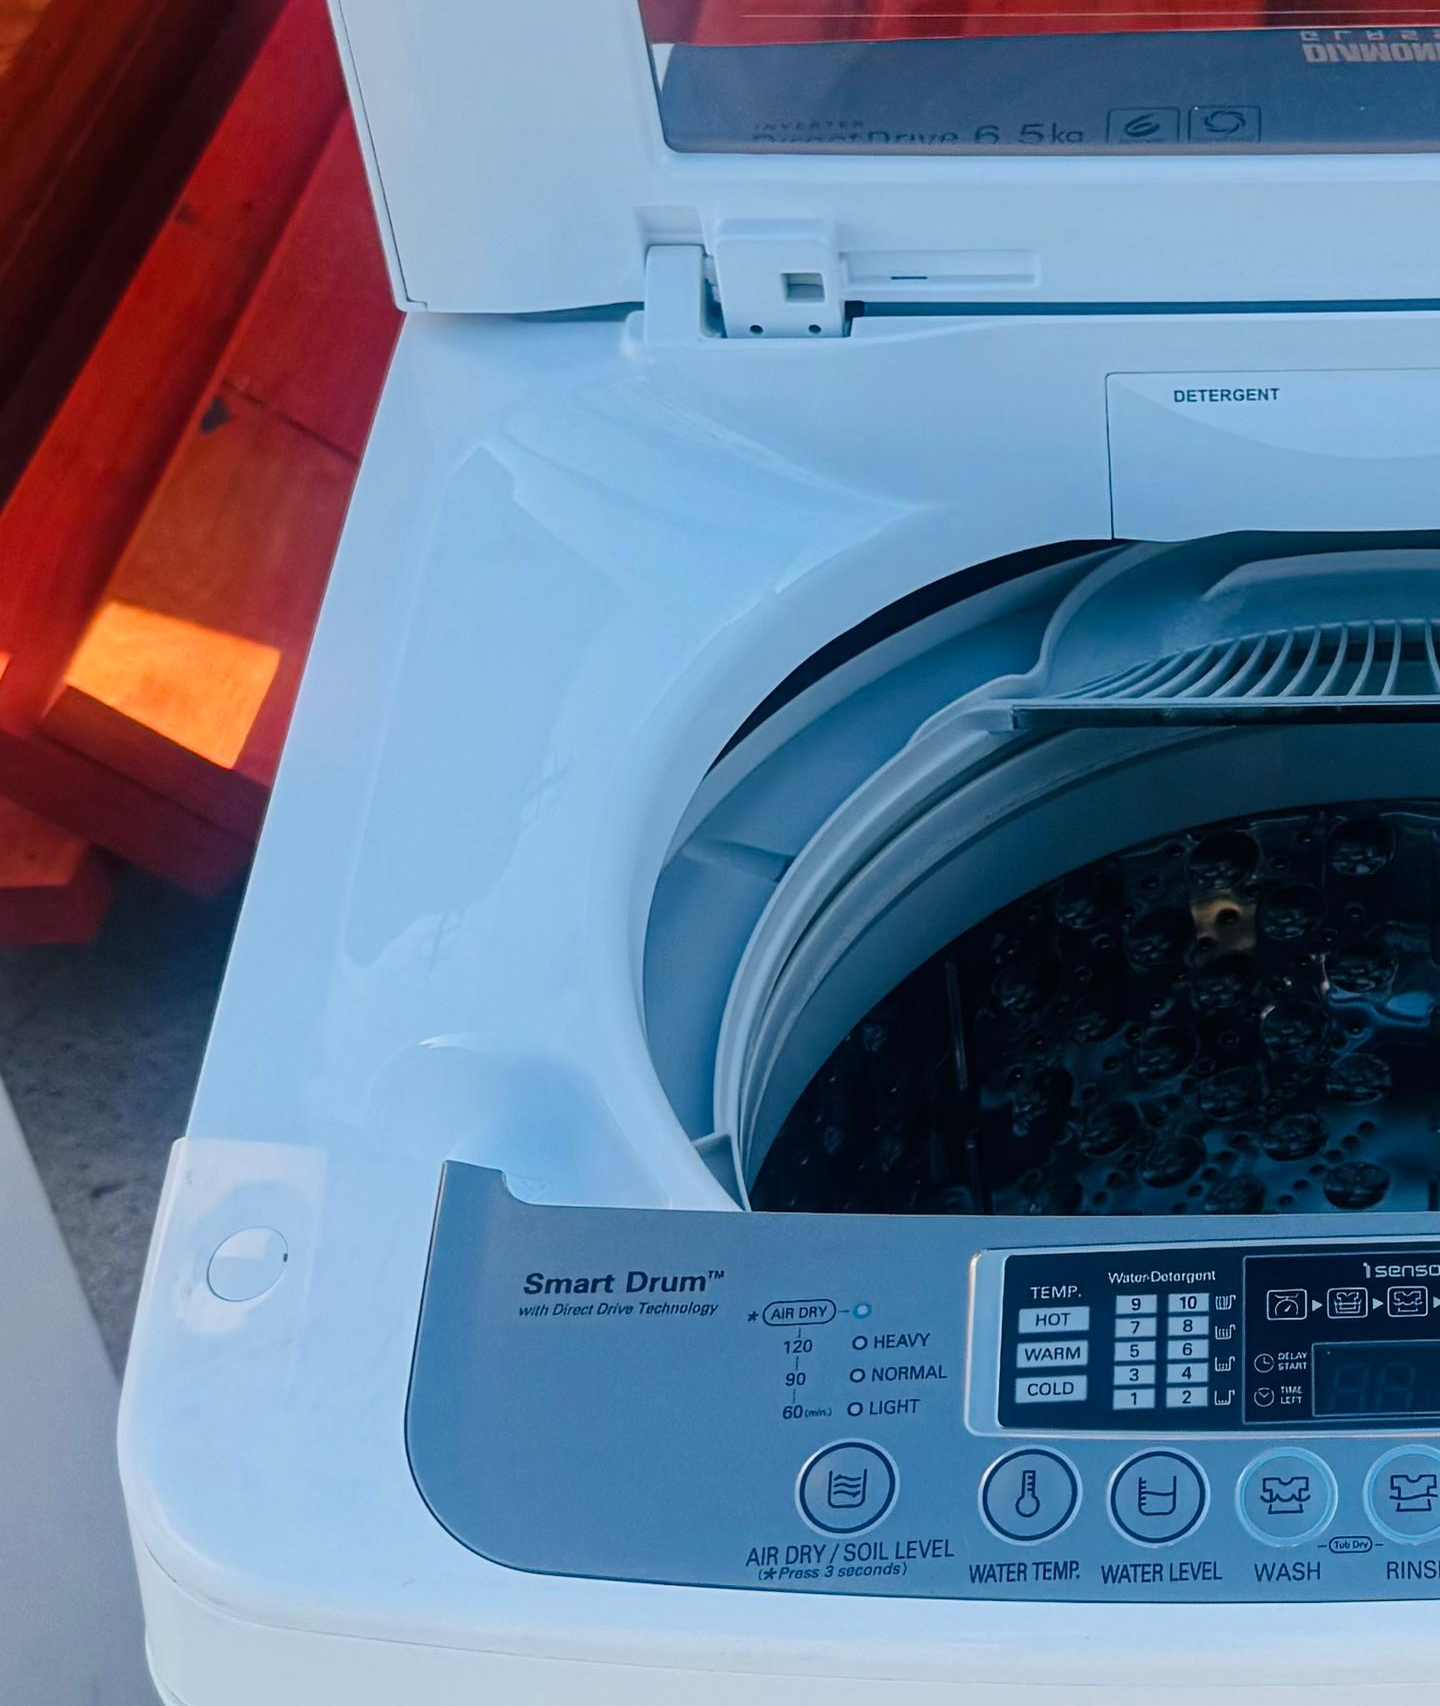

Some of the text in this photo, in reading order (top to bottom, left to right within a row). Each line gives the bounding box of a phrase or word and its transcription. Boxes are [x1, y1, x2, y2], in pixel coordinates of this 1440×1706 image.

[1173, 387, 1280, 403] DETERGENT
[523, 1272, 615, 1295] Smart
[1030, 1285, 1083, 1300] TEMP.
[518, 1300, 719, 1318] with Direct Drive Technology
[1130, 1296, 1197, 1311] 9 10
[770, 1304, 828, 1320] AIR DRY
[1035, 1312, 1071, 1327] HOT
[1130, 1318, 1193, 1334] 7 8
[783, 1338, 813, 1354] 120
[873, 1332, 931, 1349] HEAVY
[1024, 1346, 1081, 1362] WARM
[1130, 1342, 1193, 1358] 5 6
[1277, 1351, 1307, 1361] DELAY
[871, 1364, 947, 1382] NORMAL
[1130, 1366, 1193, 1382] 3 4
[1277, 1361, 1308, 1371] START
[784, 1370, 807, 1387] 90
[1027, 1381, 1074, 1397] COLD
[1131, 1390, 1193, 1406] 1 2
[868, 1399, 920, 1416] LIGHT
[746, 1546, 779, 1567] AIR
[784, 1544, 827, 1565] DRY
[843, 1541, 891, 1562] SOIL
[895, 1539, 955, 1559] LEVEL
[825, 1564, 835, 1579] 3
[838, 1562, 908, 1578] seconds)
[969, 1560, 1081, 1584] WATER TEMP.
[1101, 1561, 1223, 1585] WATER LEVEL
[1254, 1561, 1321, 1582] WASH
